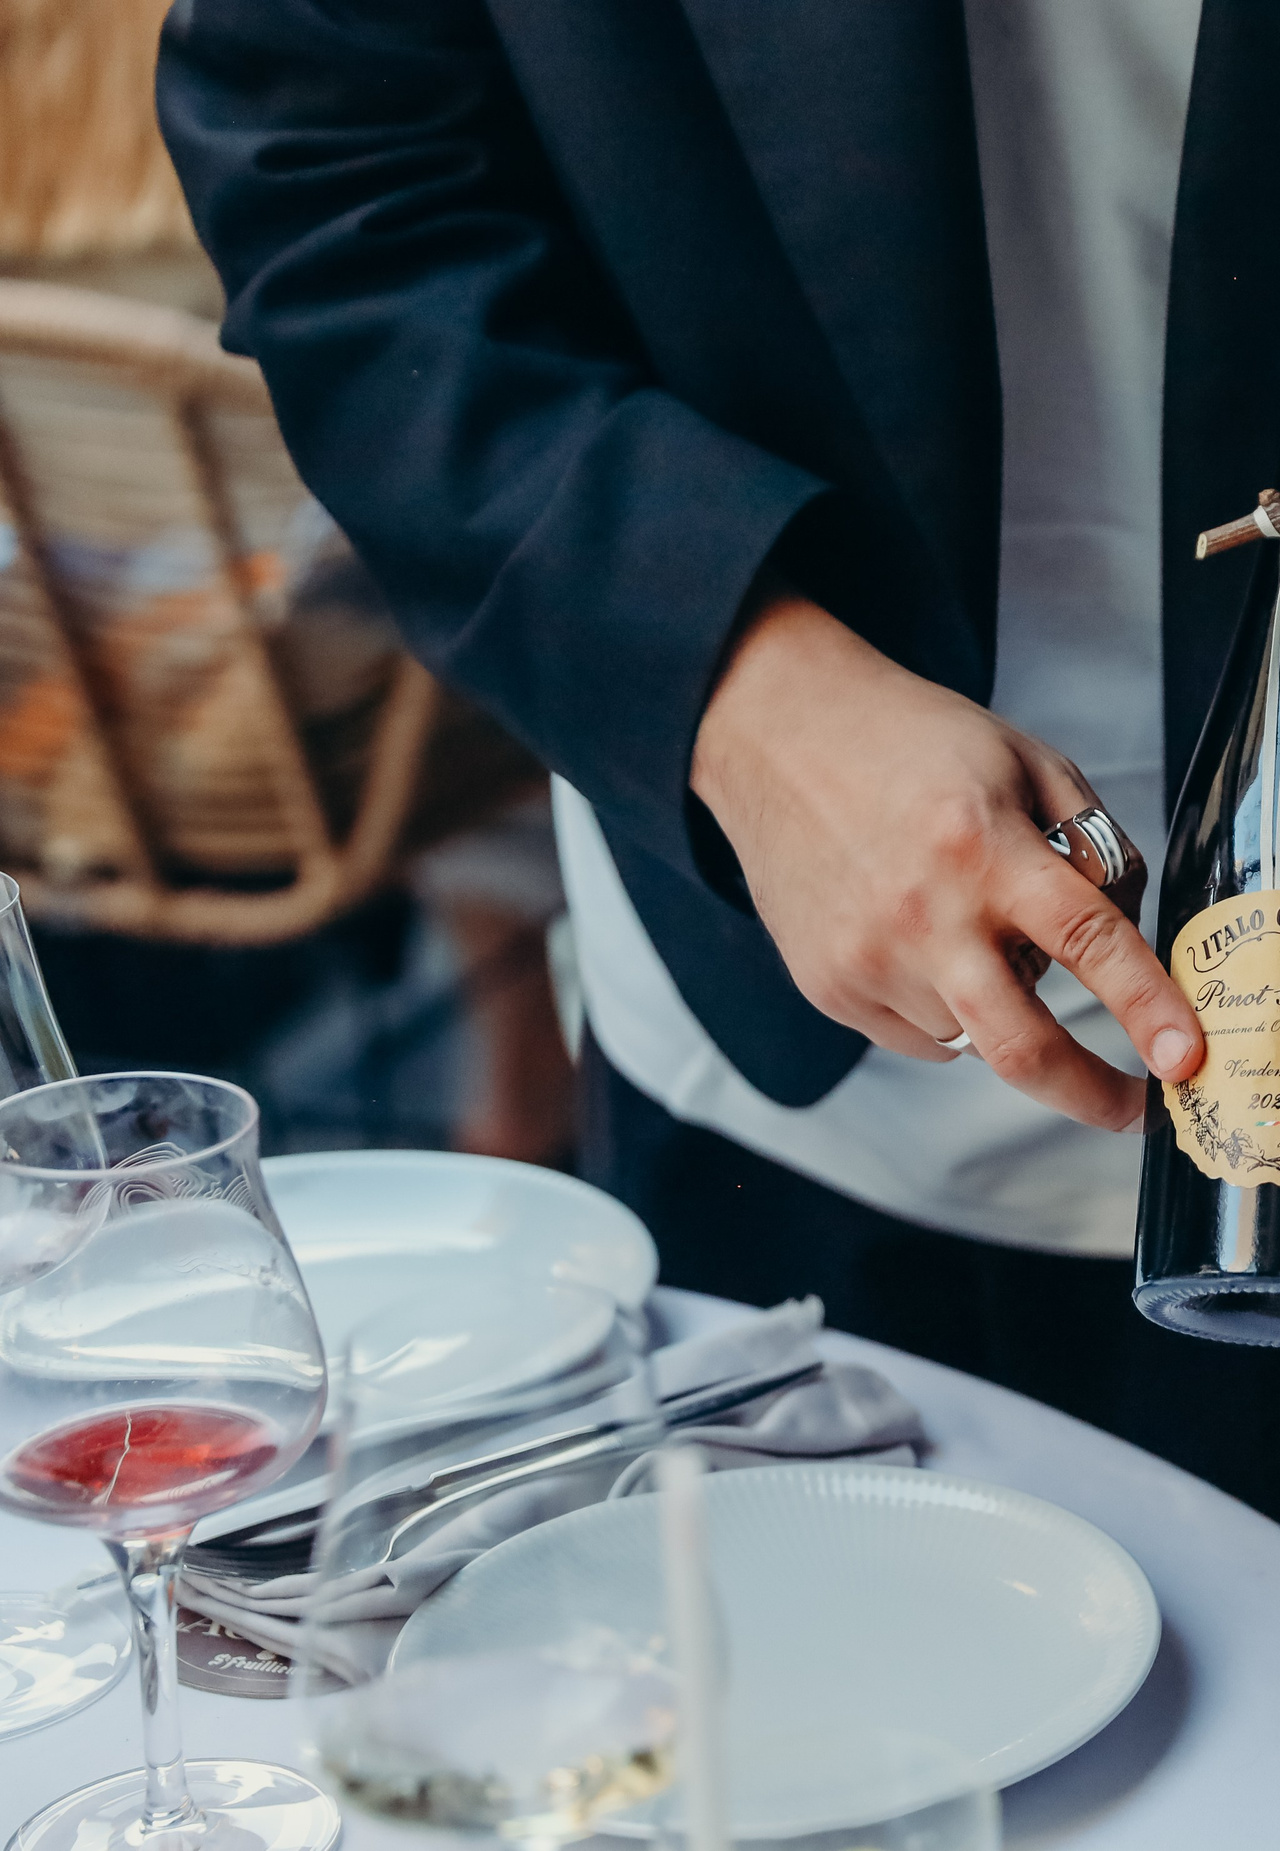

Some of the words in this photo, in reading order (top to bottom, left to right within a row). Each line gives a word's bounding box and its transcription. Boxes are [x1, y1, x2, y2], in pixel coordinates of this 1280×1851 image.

[1201, 908, 1265, 960] ITALO
[1195, 979, 1274, 1012] Pinot
[1254, 1020, 1267, 1033] di
